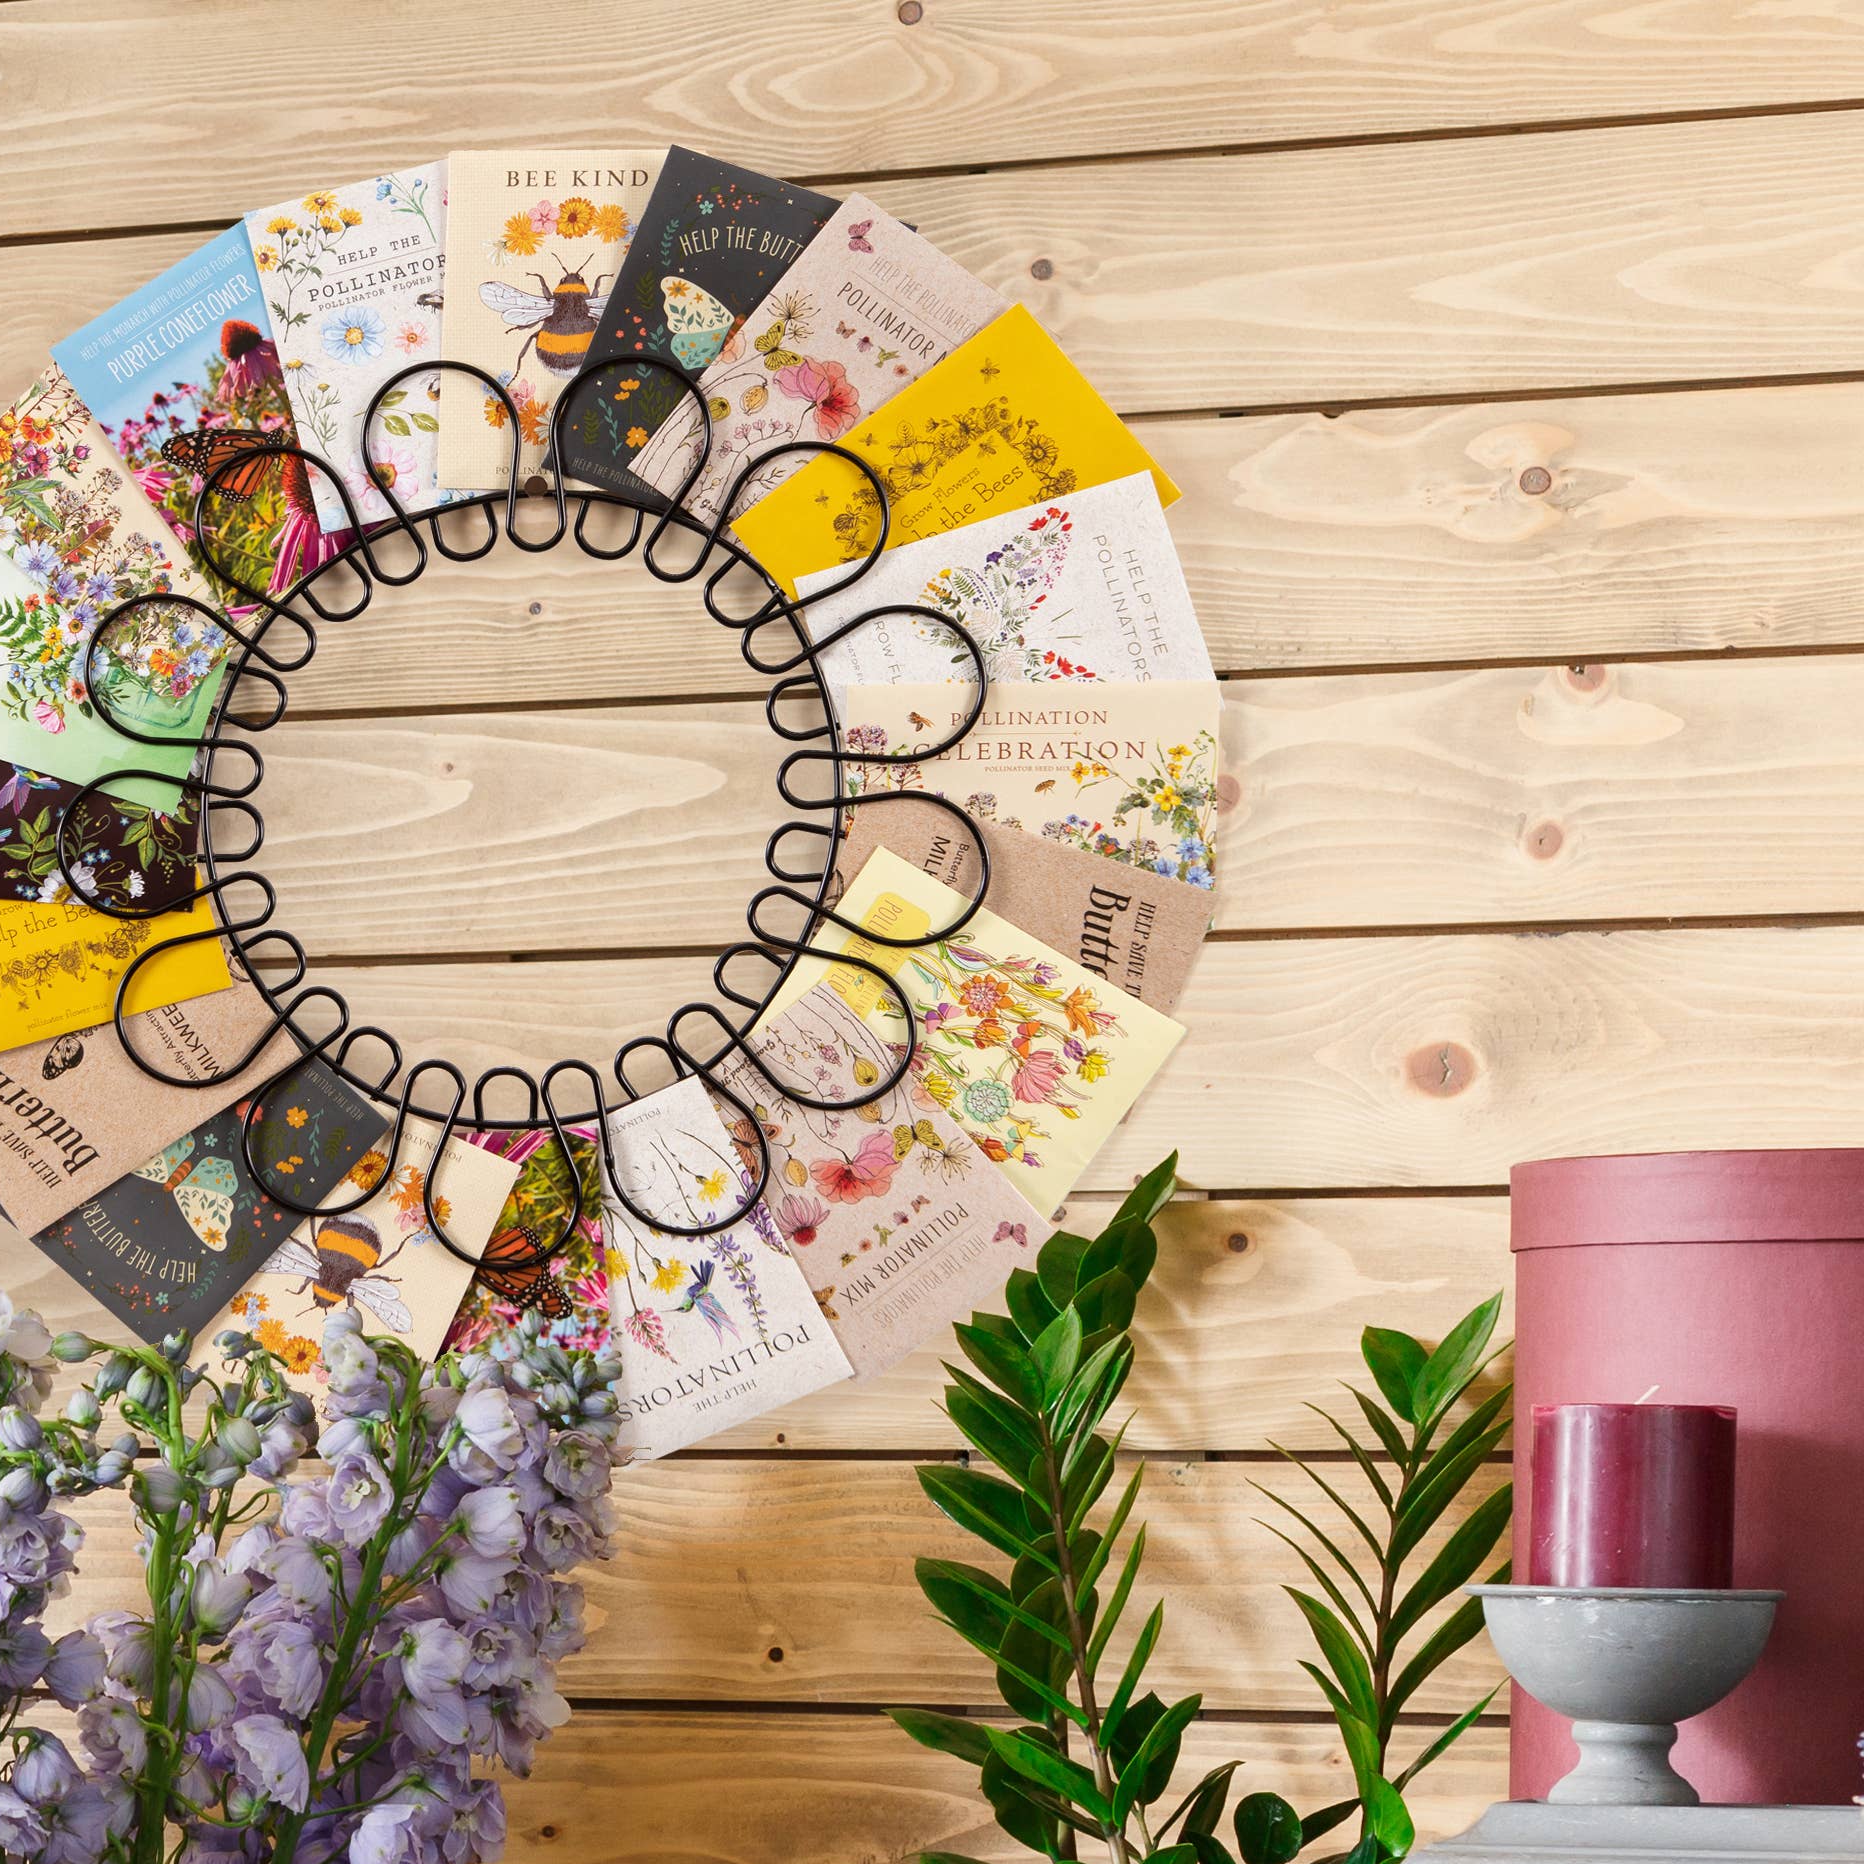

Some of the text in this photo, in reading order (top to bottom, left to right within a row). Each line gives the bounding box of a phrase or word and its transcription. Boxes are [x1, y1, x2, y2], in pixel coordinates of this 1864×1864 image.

[506, 169, 649, 187] BEE KIND
[337, 234, 421, 266] HELP THE
[679, 227, 719, 257] HELP
[726, 226, 757, 251] THE
[869, 256, 900, 284] HELP
[318, 288, 386, 312] POLLINATOR
[392, 275, 433, 292] FLOWER
[106, 273, 257, 384] PURPLE CONEFLOWER
[837, 281, 935, 360] POLLINATOR
[900, 467, 980, 529] Grow Flowers
[939, 465, 1024, 530] the Bees
[1092, 534, 1152, 683] POLLINATORS
[1122, 549, 1169, 657] HELP THE
[873, 620, 895, 657] ROW
[23, 911, 58, 935] the
[1134, 901, 1158, 940] HELP
[1126, 940, 1148, 980] SAVE
[0, 1129, 35, 1160] SAVE
[28, 1158, 63, 1189] HELP
[126, 1245, 157, 1276] THE
[159, 1258, 196, 1284] HELP
[839, 1202, 969, 1307] POLLINATOR MIX
[616, 1324, 811, 1422] POLLINATORS
[694, 1378, 757, 1414] HELP THE
